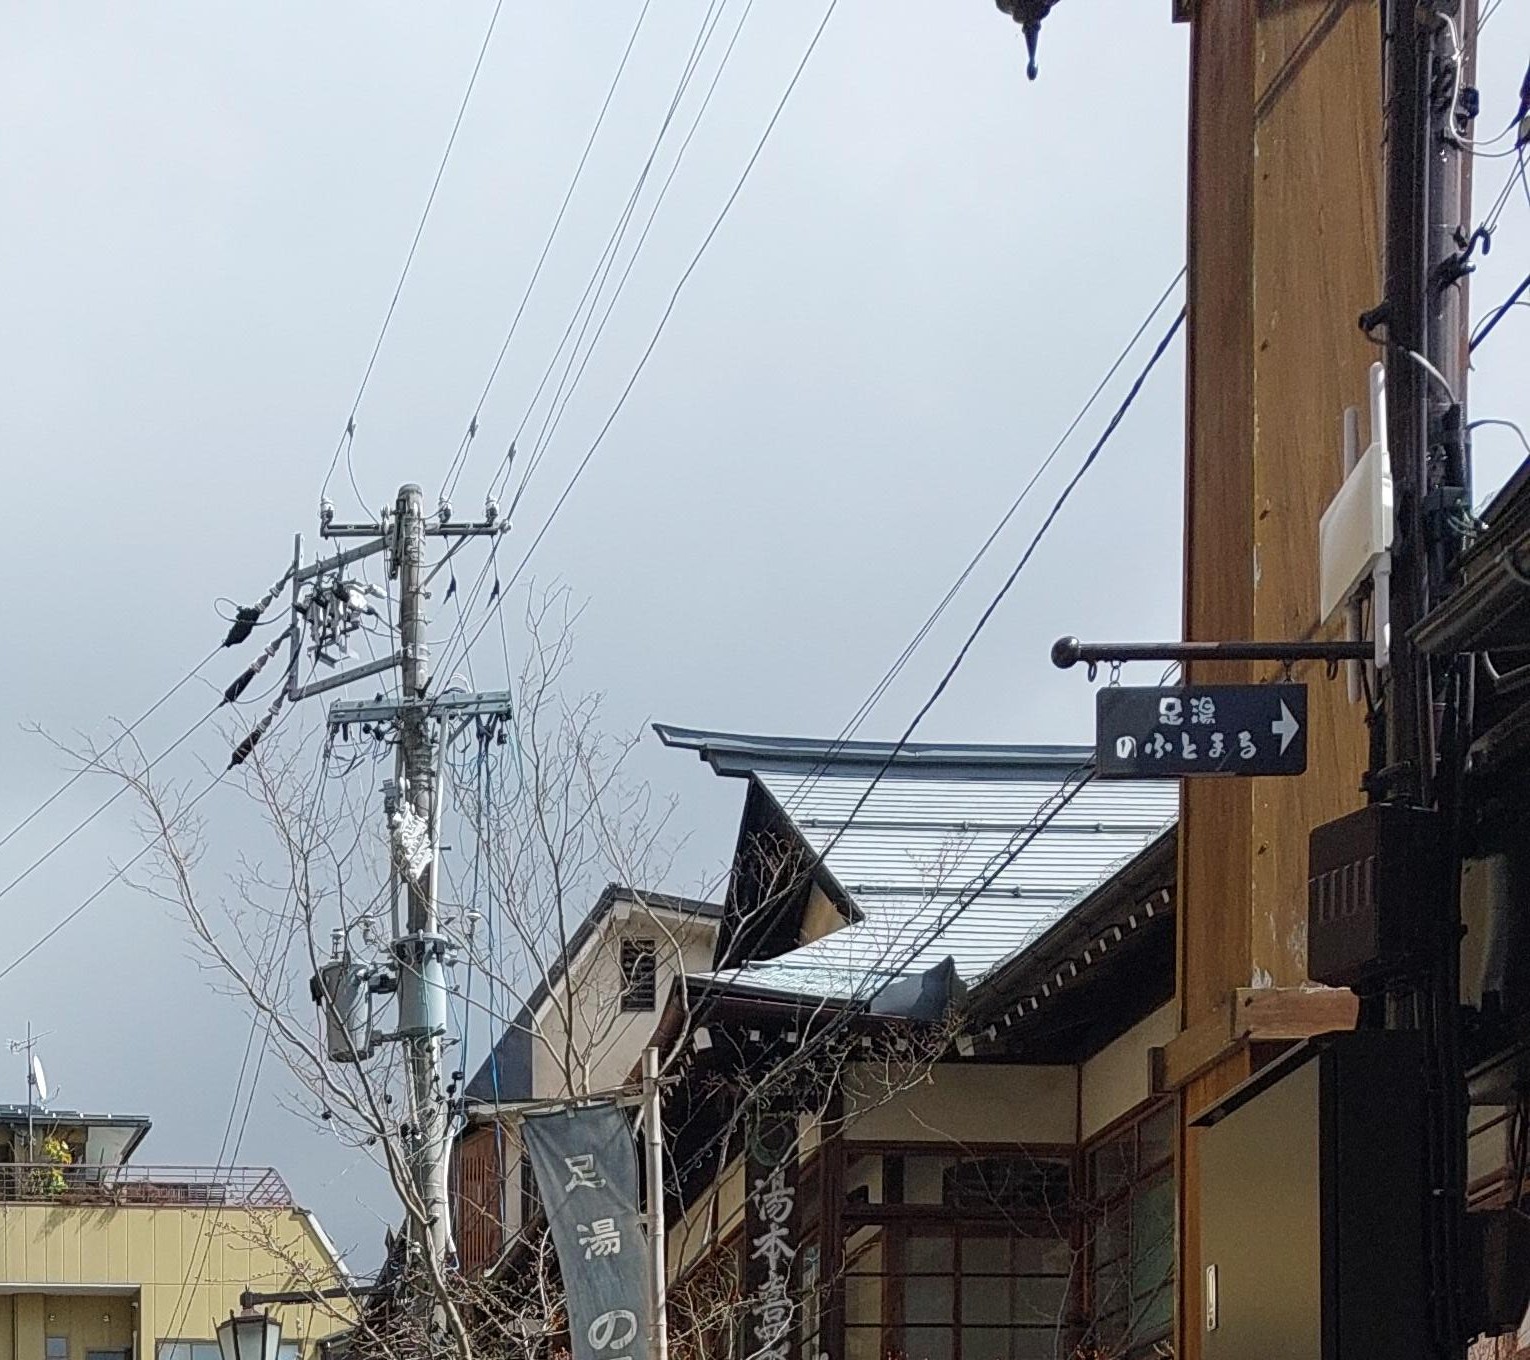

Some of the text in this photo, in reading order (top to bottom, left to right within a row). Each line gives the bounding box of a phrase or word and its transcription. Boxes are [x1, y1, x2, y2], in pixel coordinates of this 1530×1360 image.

[1159, 696, 1216, 726] 足湯
[1116, 730, 1257, 760] のふとまる
